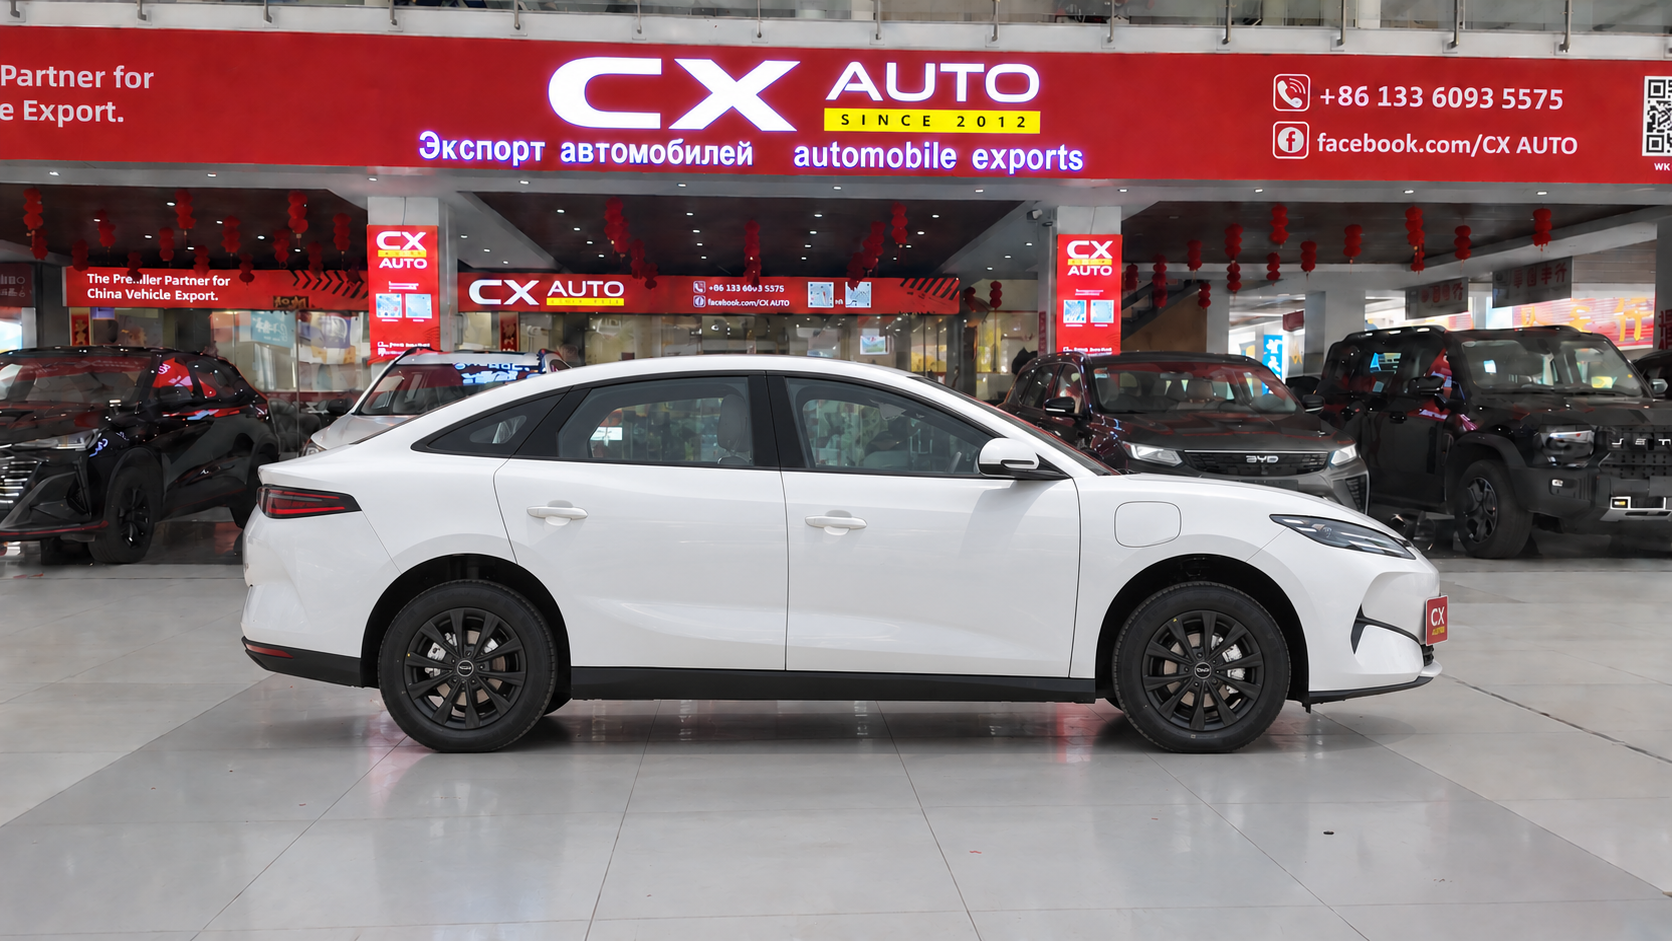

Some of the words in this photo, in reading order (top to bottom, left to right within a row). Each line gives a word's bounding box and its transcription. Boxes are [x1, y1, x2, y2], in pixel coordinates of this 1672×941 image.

[0, 64, 106, 88] Partner
[113, 65, 155, 89] for
[825, 61, 1040, 103] AUTO
[547, 57, 801, 132] CX
[1319, 86, 1370, 107] +86
[1377, 86, 1424, 108] 133
[1432, 87, 1494, 109] 6093
[1502, 88, 1563, 110] 5575
[23, 99, 124, 128] Export.
[841, 114, 931, 127] SINCE
[956, 116, 1026, 128] 2012
[419, 130, 546, 167] Экспорт
[560, 138, 754, 166] автомобилей
[1317, 132, 1511, 158] facebook.com/CX
[1516, 136, 1578, 155] AUTO
[793, 141, 957, 169] automobile
[971, 144, 1084, 175] exports
[376, 230, 427, 252] CX
[1066, 240, 1114, 259] CX
[378, 257, 428, 269] AUTO
[1067, 265, 1113, 277] AUTO
[86, 273, 110, 285] The
[164, 275, 209, 287] Partner
[212, 275, 231, 287] for
[547, 280, 625, 297] AUTO
[726, 284, 741, 293] 133
[86, 287, 123, 300] China
[124, 287, 172, 301] Vehicle
[174, 289, 220, 303] Export.
[468, 279, 540, 306] CX
[1245, 455, 1279, 463] BYD
[1430, 606, 1445, 627] CX
